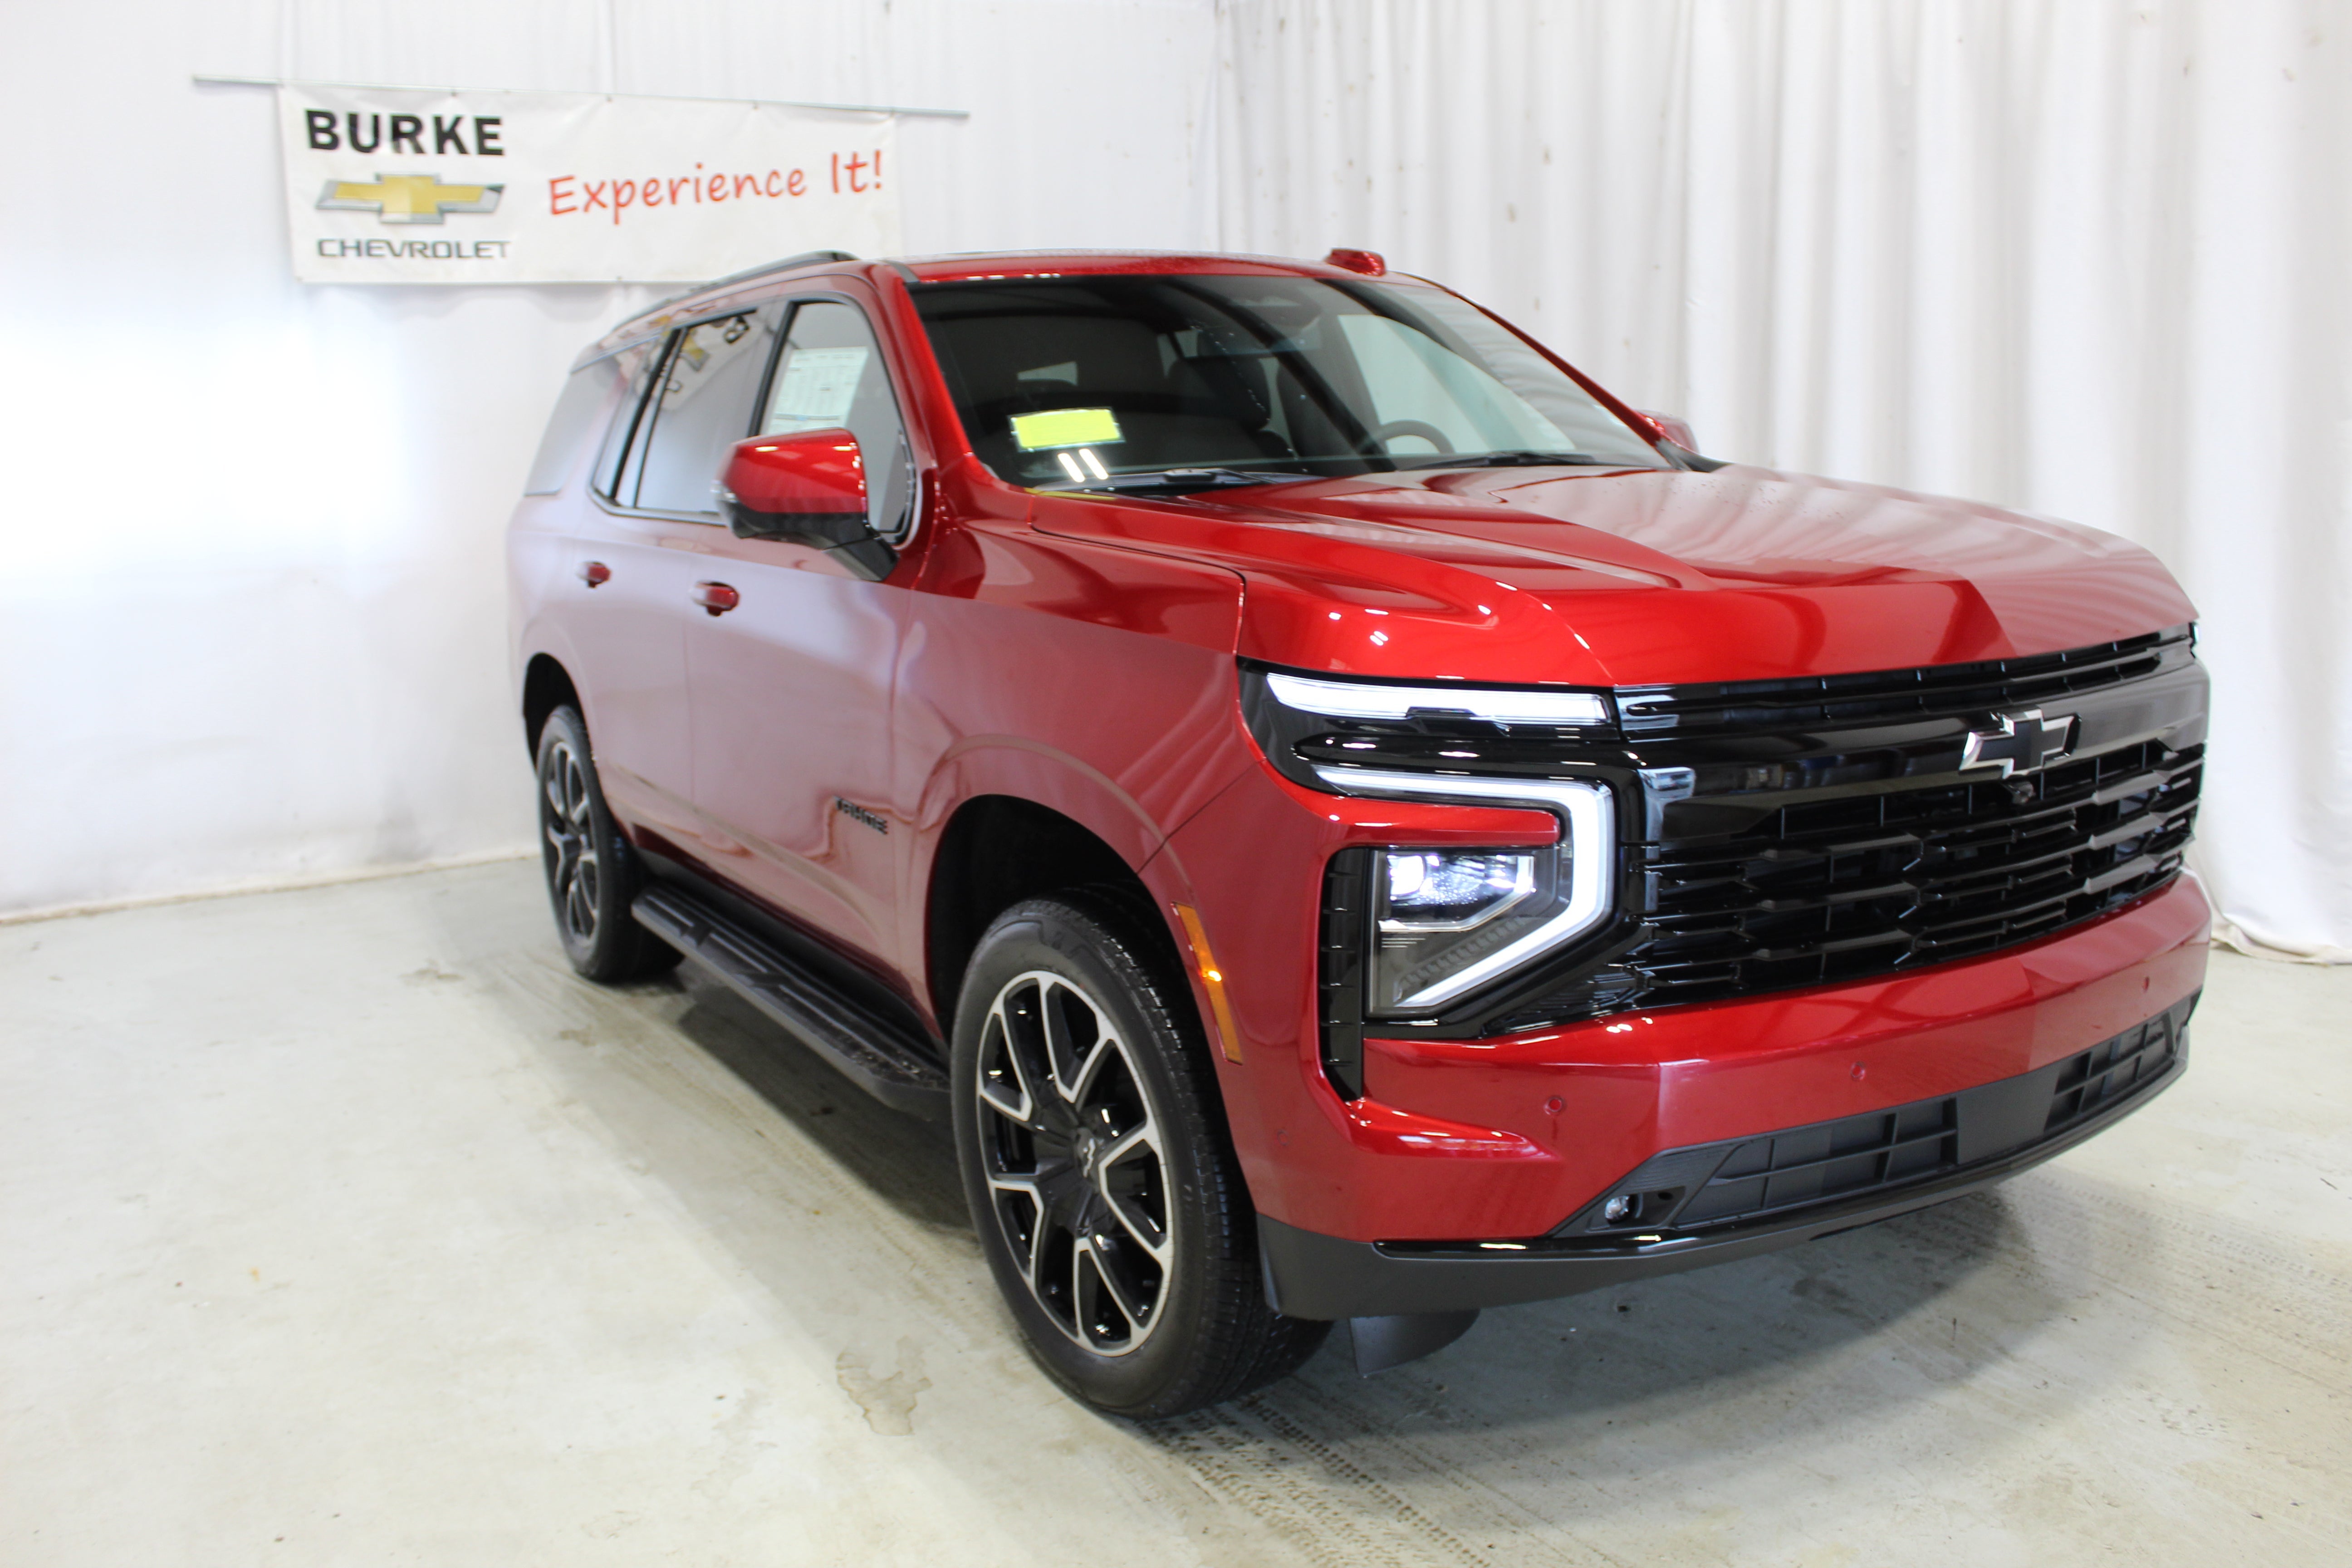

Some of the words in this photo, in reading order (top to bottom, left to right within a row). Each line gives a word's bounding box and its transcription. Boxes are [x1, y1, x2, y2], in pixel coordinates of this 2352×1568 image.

[305, 109, 505, 155] BURKE
[549, 162, 807, 225] Experience
[831, 149, 881, 193] It!
[317, 239, 511, 259] CHEVROLET
[833, 795, 888, 834] TAHOE
